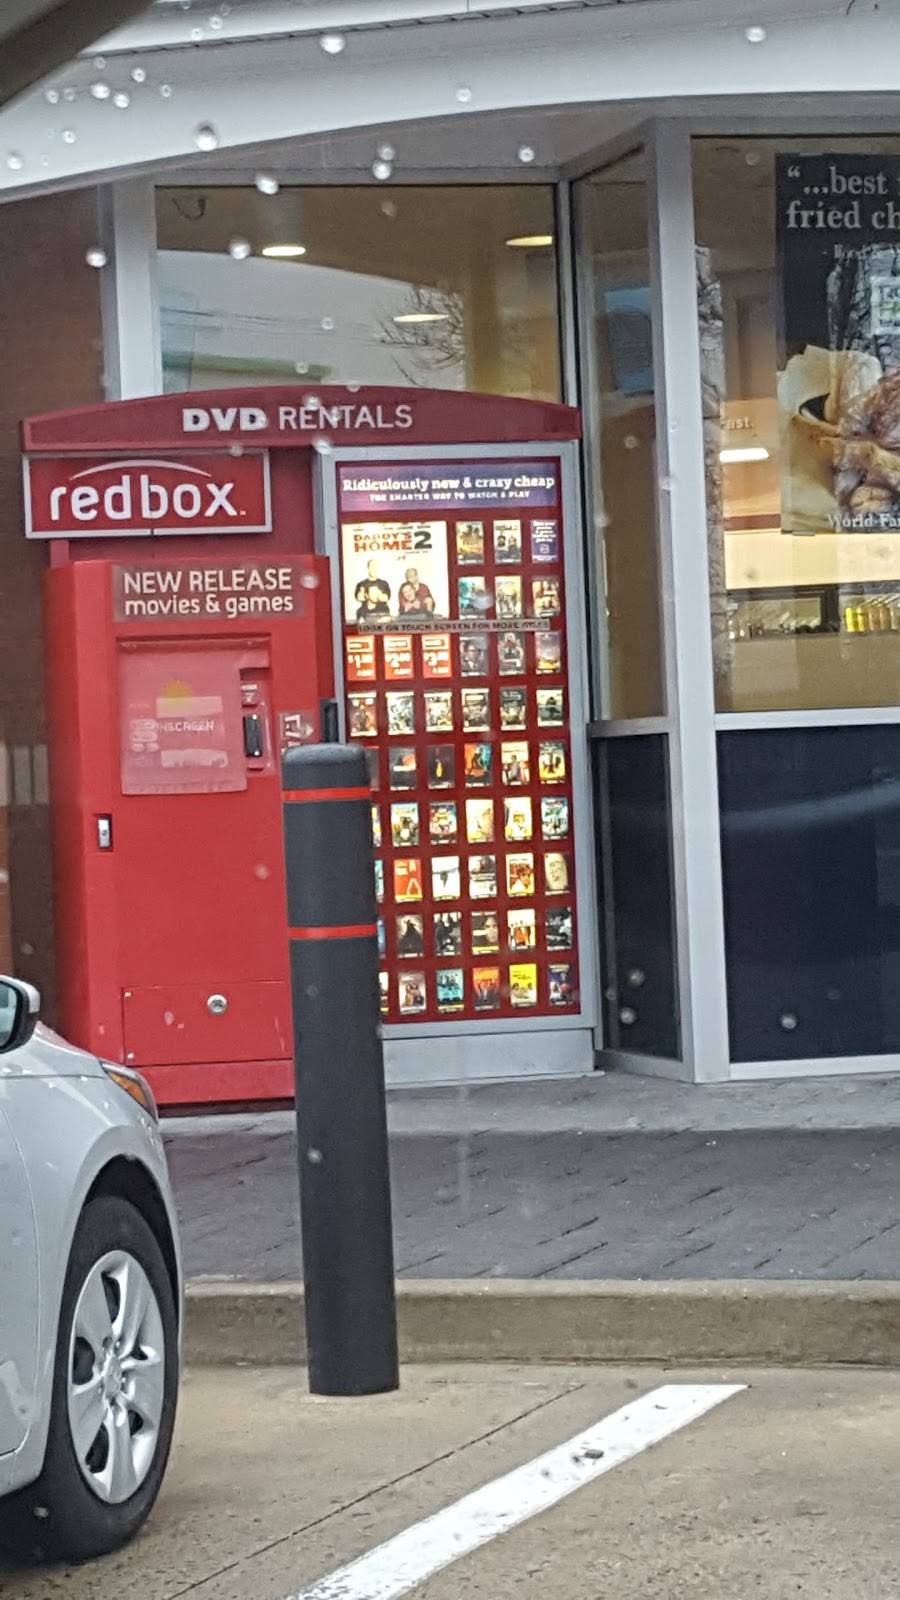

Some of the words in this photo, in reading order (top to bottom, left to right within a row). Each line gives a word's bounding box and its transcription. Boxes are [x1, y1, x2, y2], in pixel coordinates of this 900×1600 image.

[785, 200, 861, 229] fried
[182, 407, 268, 432] DVD
[278, 404, 413, 430] RENTALS
[342, 478, 430, 492] Ridiculously
[432, 479, 460, 489] new
[463, 476, 472, 488] &
[475, 478, 512, 490] crazy
[514, 475, 555, 489] cheap
[508, 490, 530, 499] PLAY
[354, 540, 413, 553] HOME
[414, 530, 433, 550] 2
[124, 571, 182, 594] NEW
[189, 568, 292, 592] RELEASE
[125, 595, 200, 615] movies
[206, 594, 220, 613] &
[225, 595, 293, 618] games
[401, 623, 431, 631] TOUCH
[434, 622, 471, 630] SCREEN
[492, 621, 519, 629] MORE
